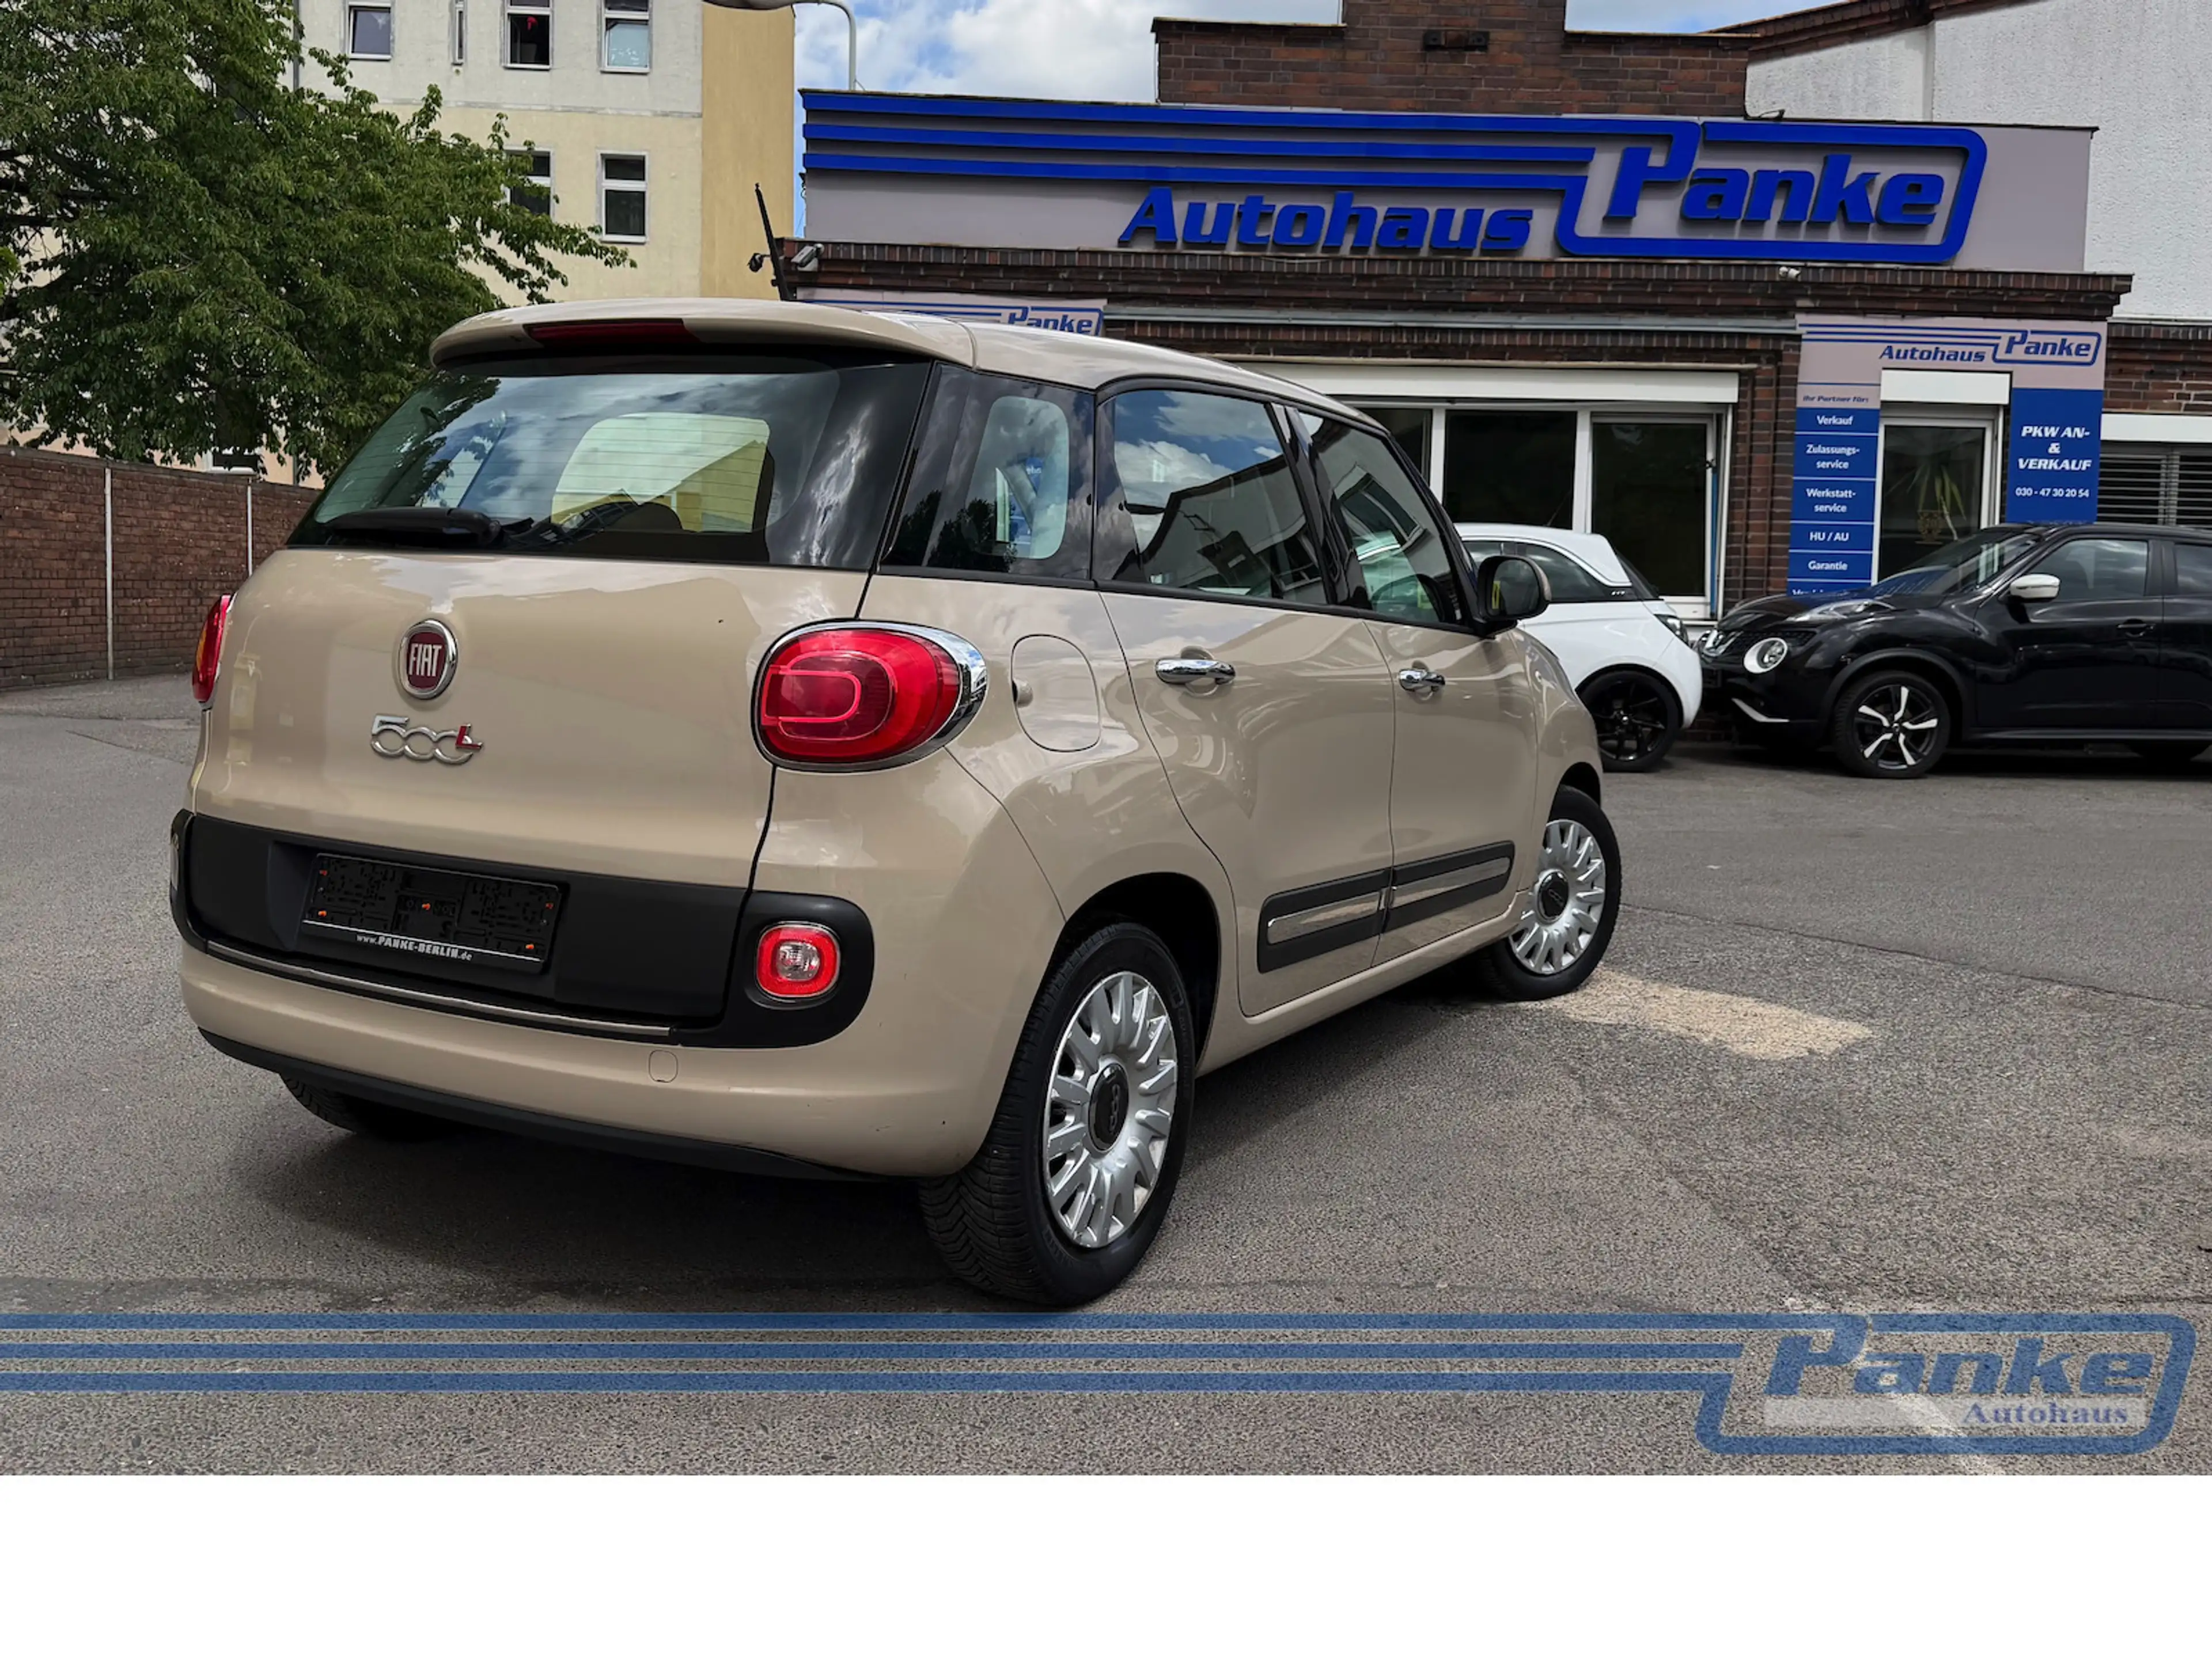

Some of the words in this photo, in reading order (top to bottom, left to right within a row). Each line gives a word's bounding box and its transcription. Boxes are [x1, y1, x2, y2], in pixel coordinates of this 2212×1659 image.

[1118, 185, 1532, 253] Autohaus
[1603, 121, 1946, 225] Panke
[1008, 306, 1093, 334] Panke
[1878, 345, 1986, 362] Autohaus
[2005, 330, 2092, 357] Panke
[1816, 415, 1854, 425] Verkauf
[2021, 426, 2060, 438] PKW
[2060, 426, 2090, 438] AN-
[1806, 444, 1860, 456] Zulassungs-
[2047, 442, 2061, 454] &
[1816, 460, 1850, 469] service
[2017, 458, 2093, 471] VERKAUF
[1806, 488, 1857, 499] Werkstatt-
[2015, 487, 2033, 497] 030
[2039, 487, 2052, 497] 47
[2052, 488, 2065, 497] 30
[2065, 488, 2077, 498] 20
[2078, 489, 2090, 498] 54
[1814, 503, 1847, 513] service
[1809, 532, 1825, 541] HU
[1834, 532, 1850, 541] AU
[1808, 560, 1848, 570] Garantie
[408, 643, 442, 677] FIAT
[370, 713, 484, 765] 500L
[356, 934, 473, 961] www.PANKE-BERLIN.de
